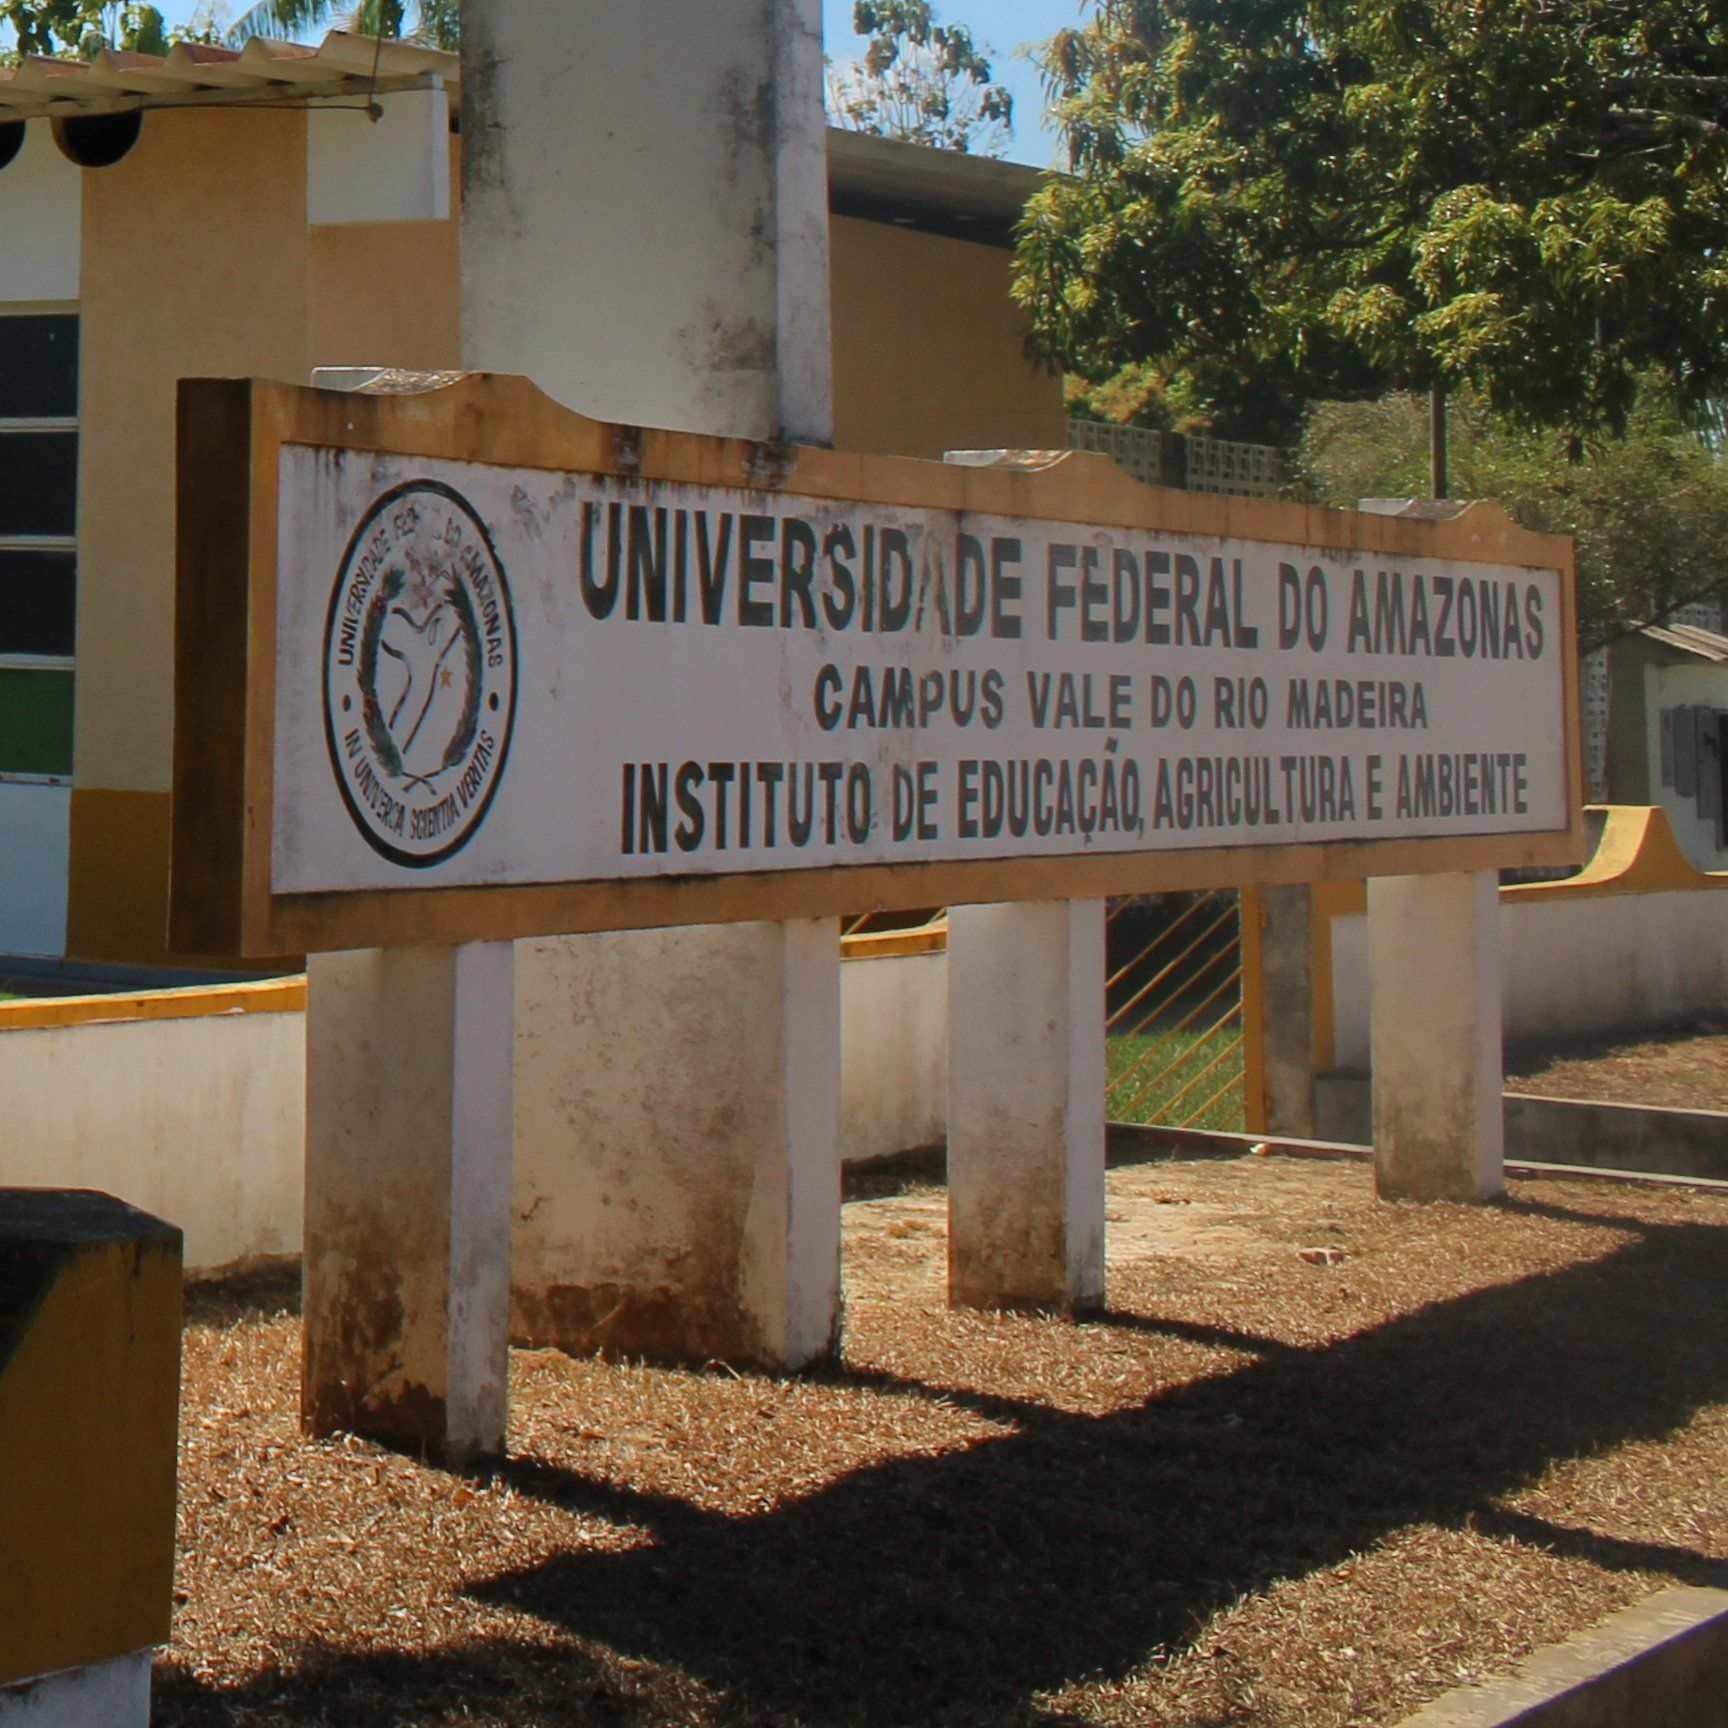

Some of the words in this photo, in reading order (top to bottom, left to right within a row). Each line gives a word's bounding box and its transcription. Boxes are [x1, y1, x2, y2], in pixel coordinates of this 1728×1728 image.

[1047, 543, 1259, 650] FEDERAL
[1278, 562, 1329, 653] DO
[1347, 569, 1545, 661] AMAZONAS
[814, 663, 1005, 731] CAMPUS
[1027, 672, 1132, 730] VALE
[1150, 675, 1196, 730] DO
[1214, 676, 1268, 730] RIO
[1286, 678, 1428, 730] MADEIRA
[456, 729, 495, 809] VERITAS
[621, 760, 872, 855] INSTITUTO
[893, 761, 939, 843] DE
[1153, 754, 1356, 831] AGRICULTURA
[1366, 754, 1383, 821] E
[1396, 752, 1529, 820] AMBIENTE
